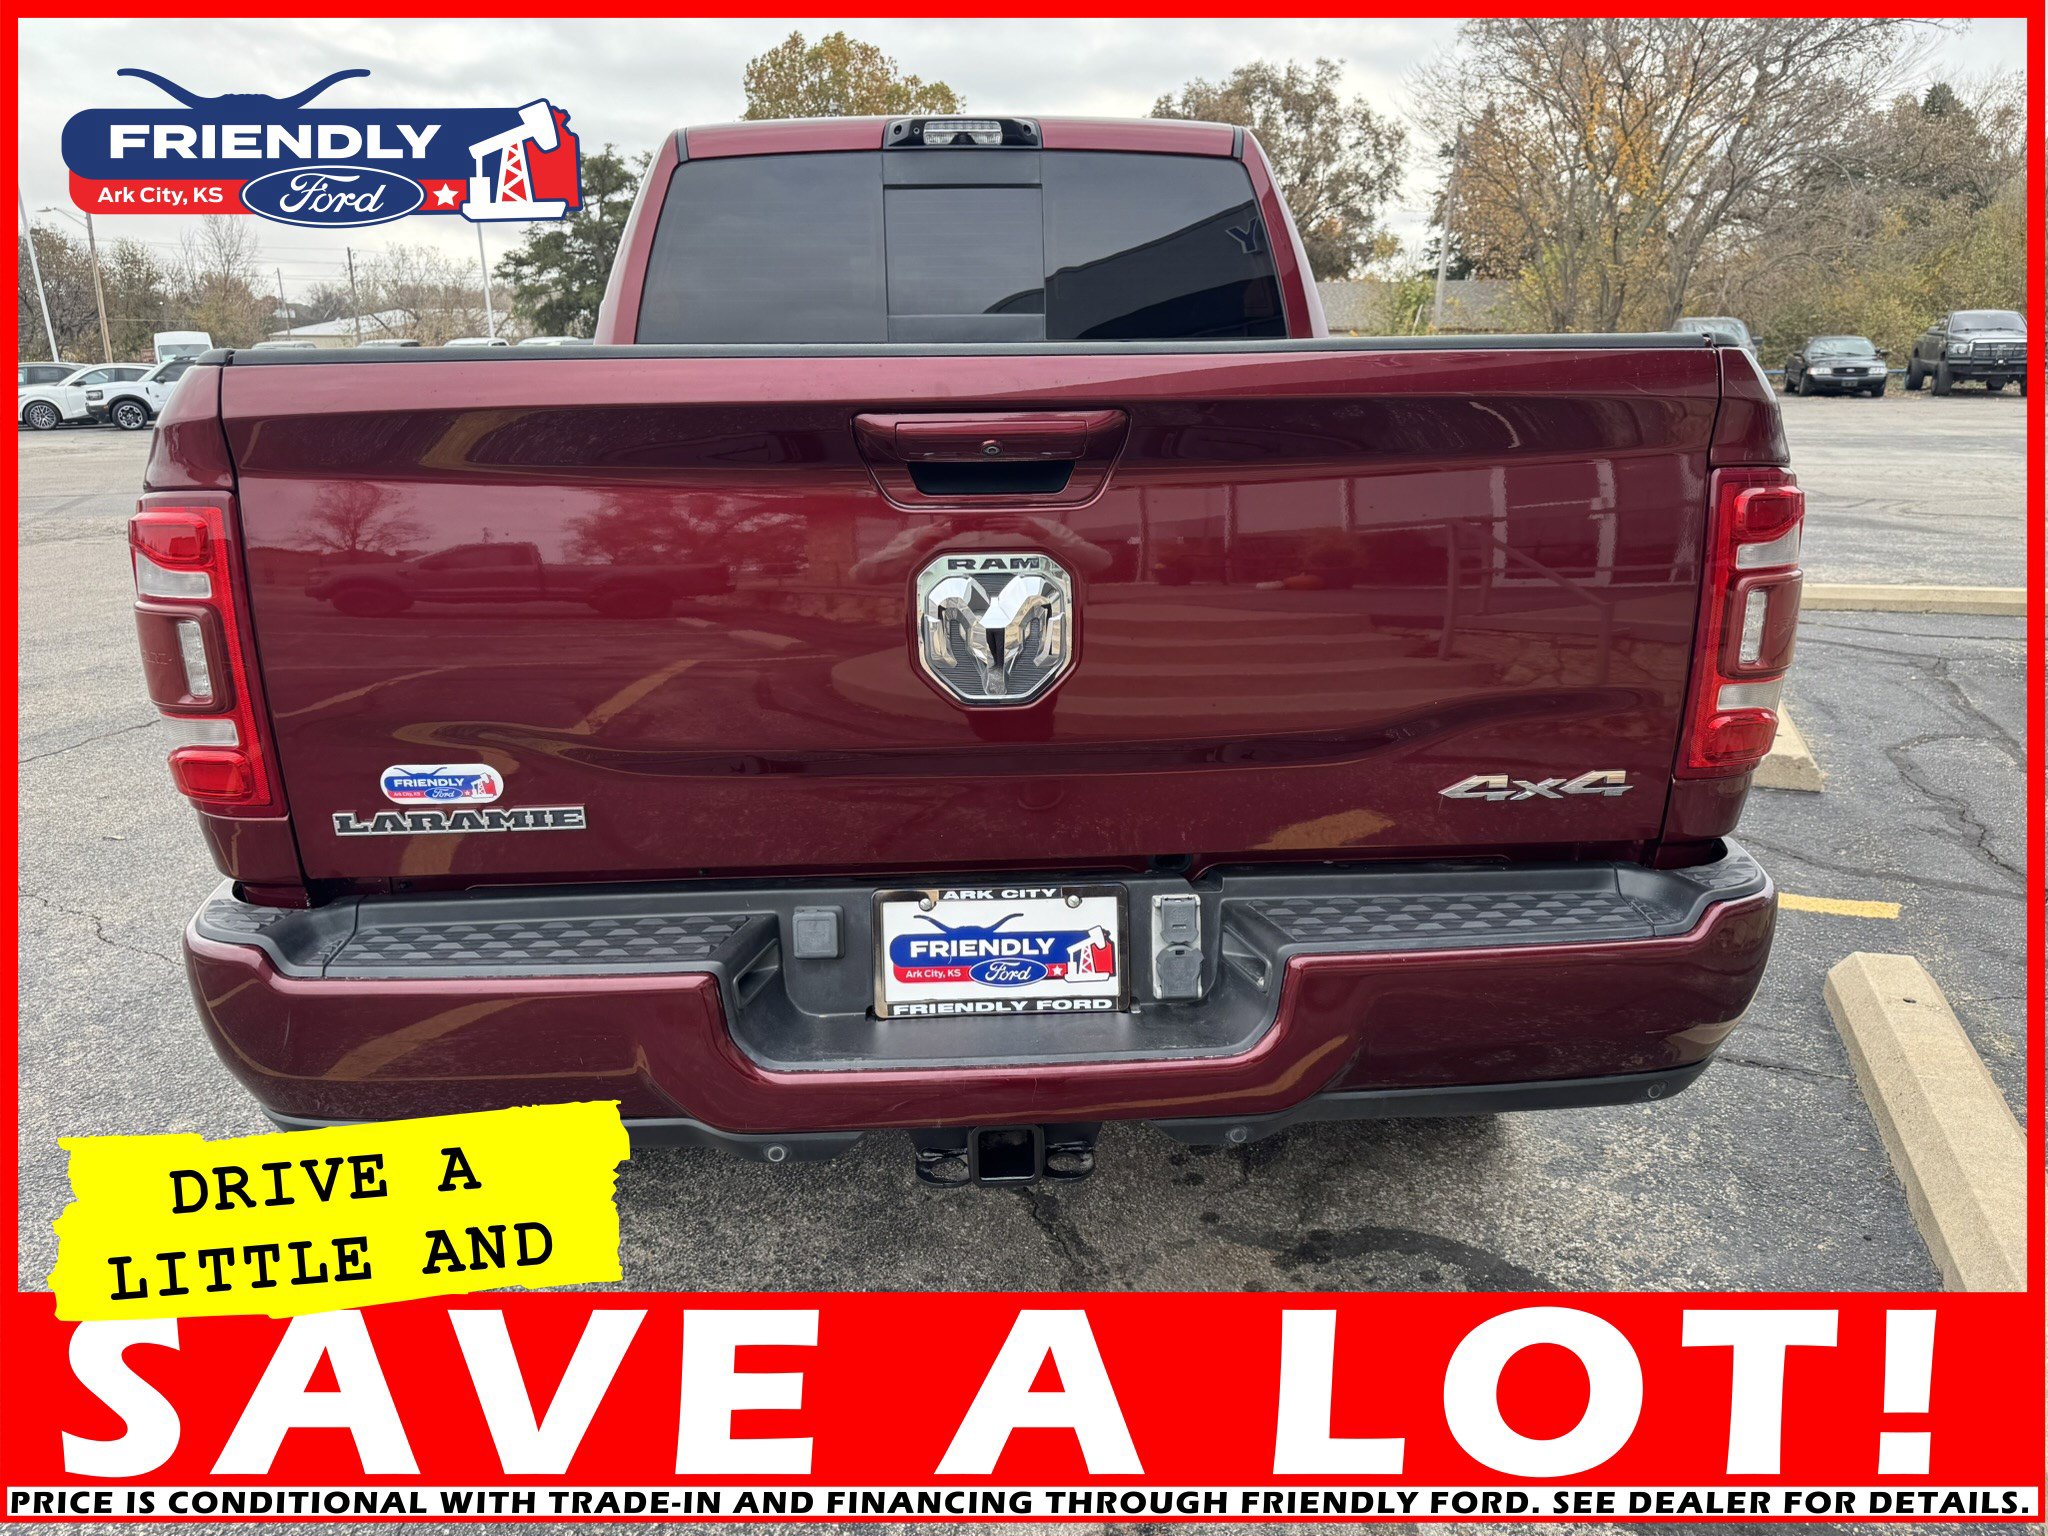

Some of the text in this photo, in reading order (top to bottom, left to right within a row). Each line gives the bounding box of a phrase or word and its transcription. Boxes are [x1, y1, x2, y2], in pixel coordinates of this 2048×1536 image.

[947, 557, 1040, 570] RAM
[393, 777, 465, 788] FRIENDLY
[431, 787, 456, 798] Ford
[332, 804, 587, 836] LARAMIE
[942, 888, 1057, 900] ARK CITY
[910, 937, 1056, 958] FRIENDLY
[905, 968, 961, 980] Ark City, KS
[984, 963, 1032, 981] Ford
[893, 998, 1113, 1016] FRIENDLY FORD
